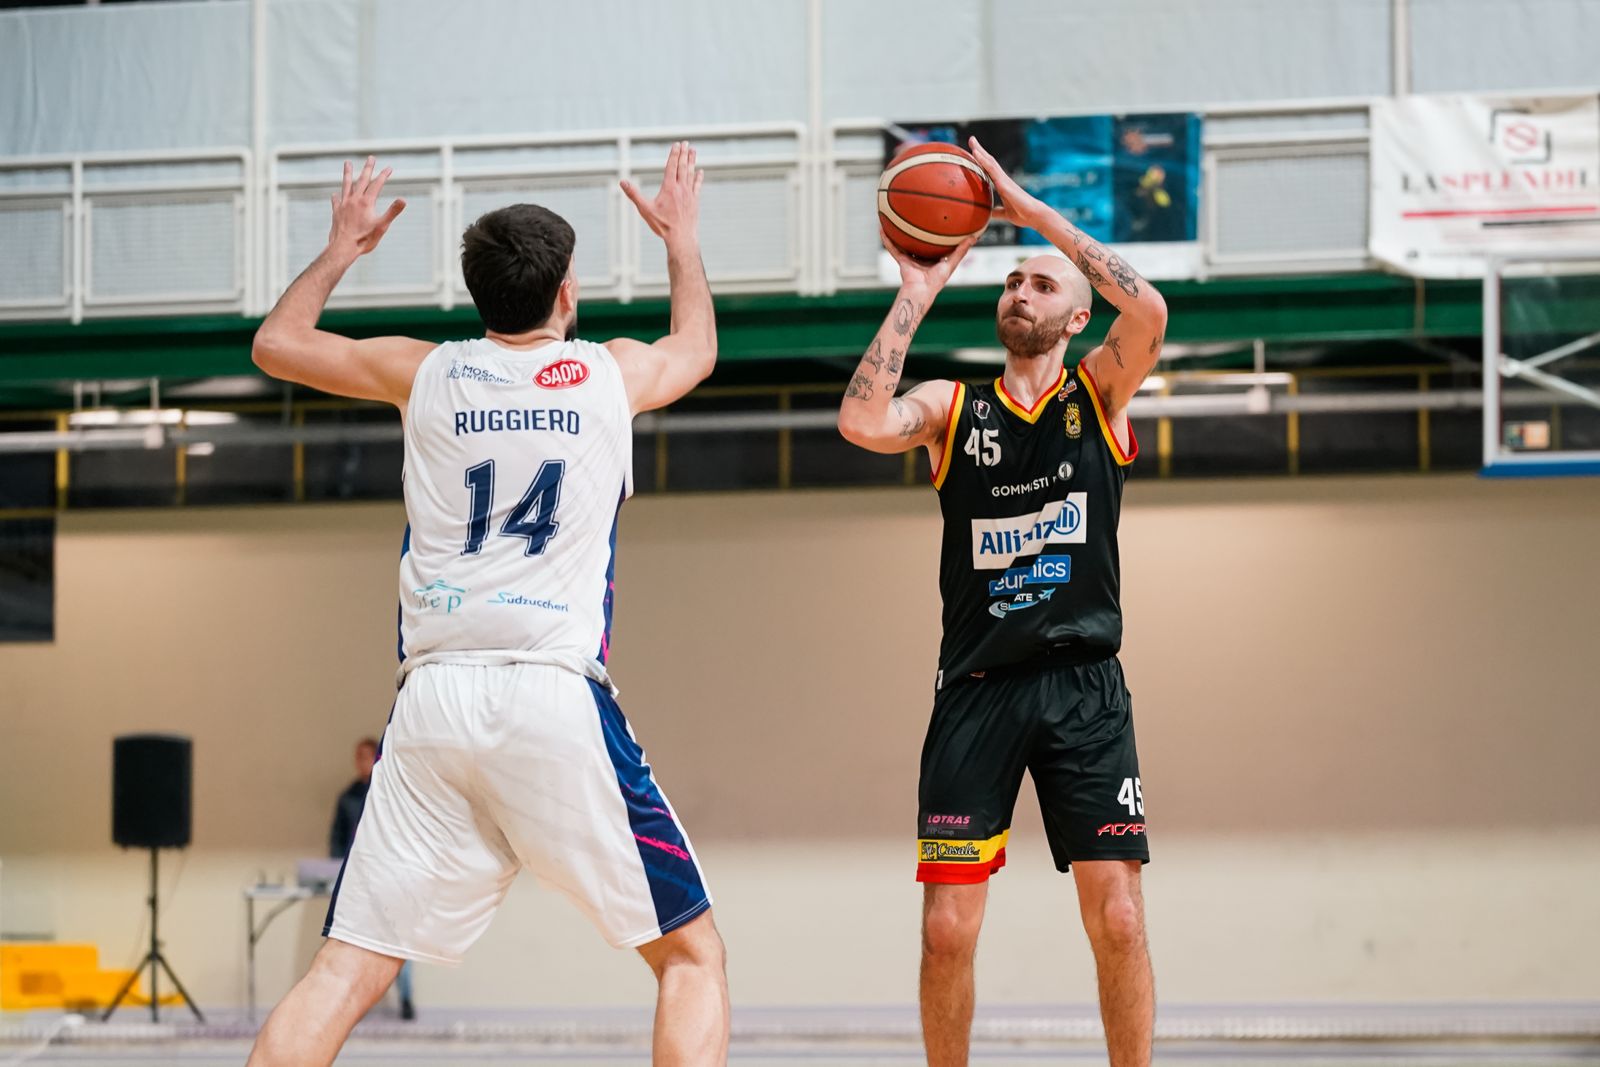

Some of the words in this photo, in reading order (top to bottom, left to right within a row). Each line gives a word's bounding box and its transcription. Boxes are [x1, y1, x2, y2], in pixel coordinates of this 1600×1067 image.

[455, 409, 580, 436] RUGGIERO
[963, 427, 1002, 467] 45
[460, 459, 566, 557] 14
[927, 815, 971, 825] LOTRAS
